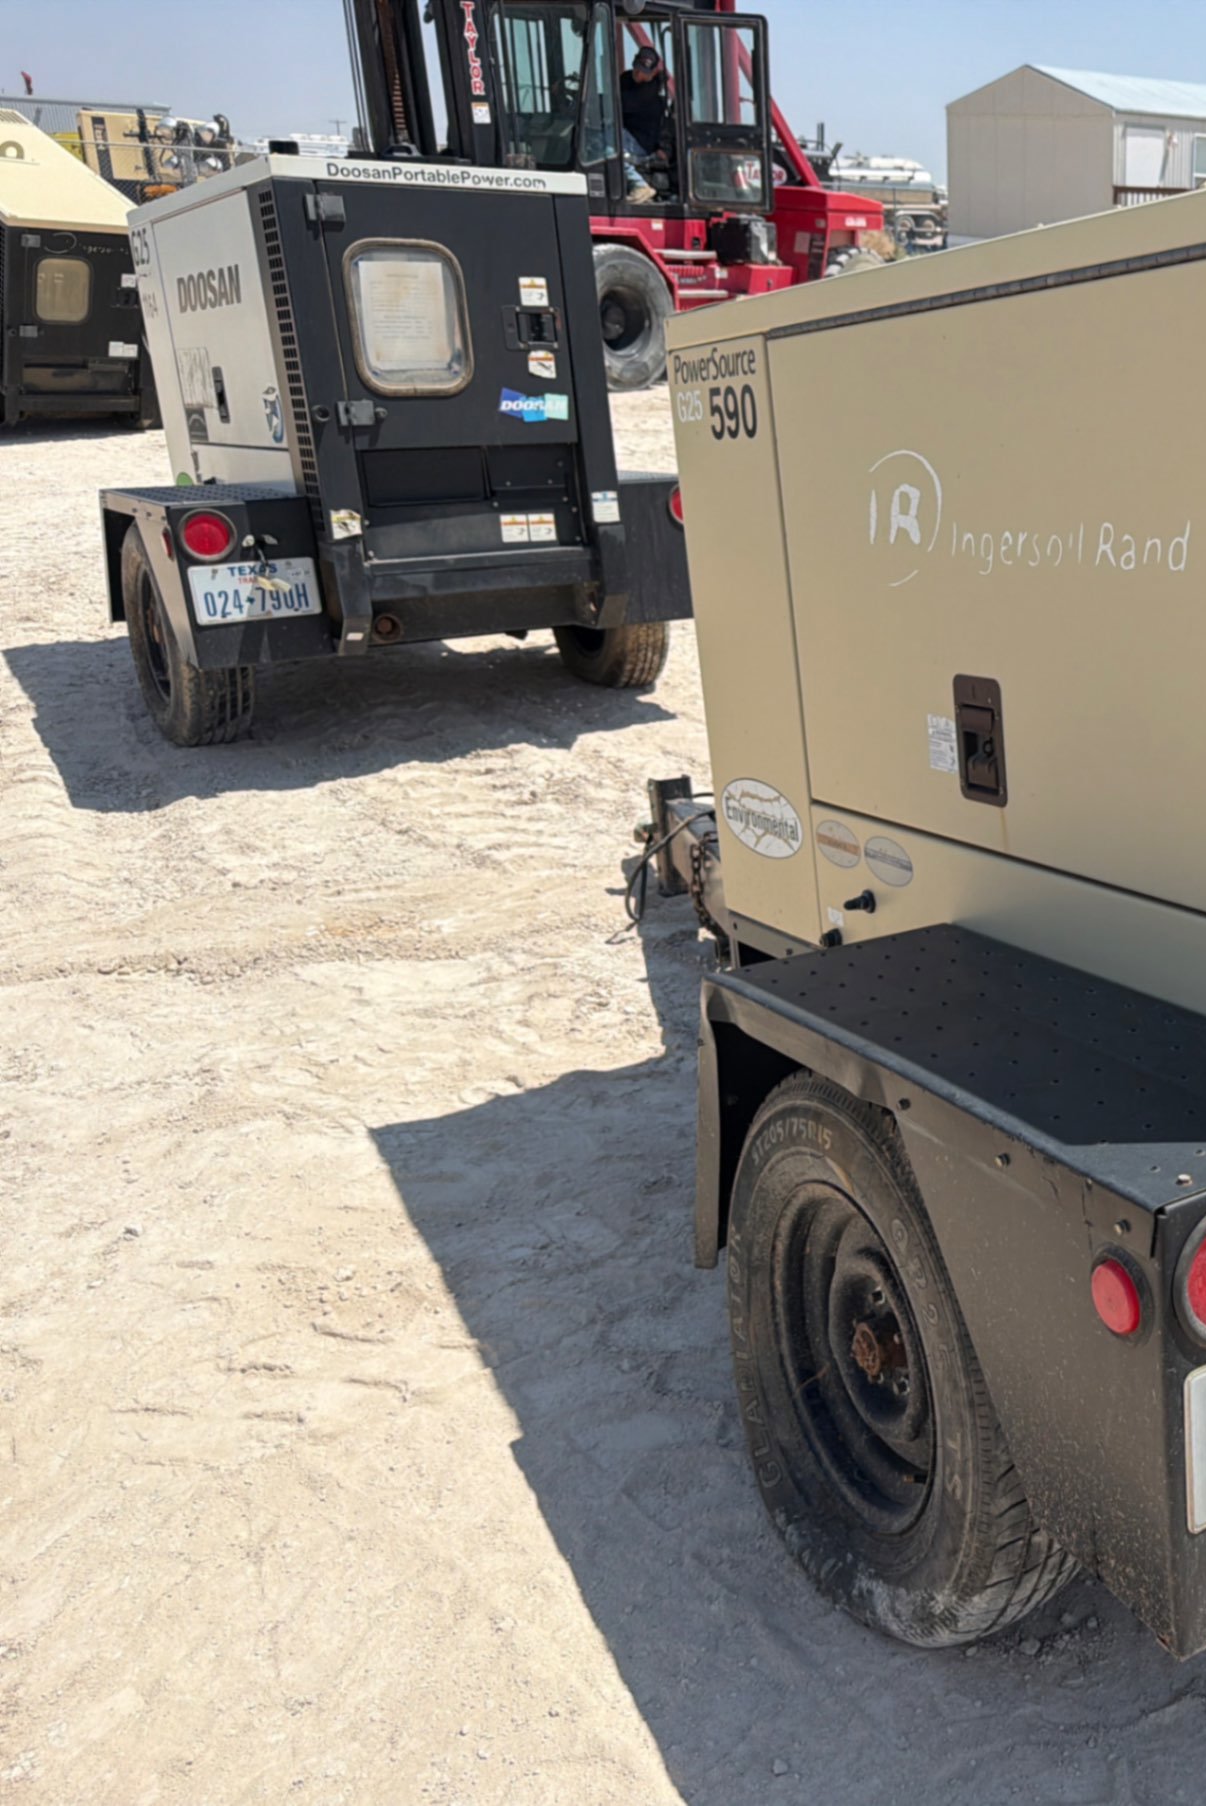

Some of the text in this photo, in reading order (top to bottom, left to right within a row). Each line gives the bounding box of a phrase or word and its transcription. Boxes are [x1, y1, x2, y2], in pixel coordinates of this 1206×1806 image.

[460, 1, 486, 95] TAYLOR
[326, 162, 547, 190] DoosanPortablePower.com
[177, 263, 242, 314] DOOSAN
[673, 347, 756, 385] PowerSource
[676, 384, 757, 441] G25 590
[227, 563, 278, 577] TEXAS
[1095, 519, 1192, 572] Rand
[723, 796, 800, 843] Environmental
